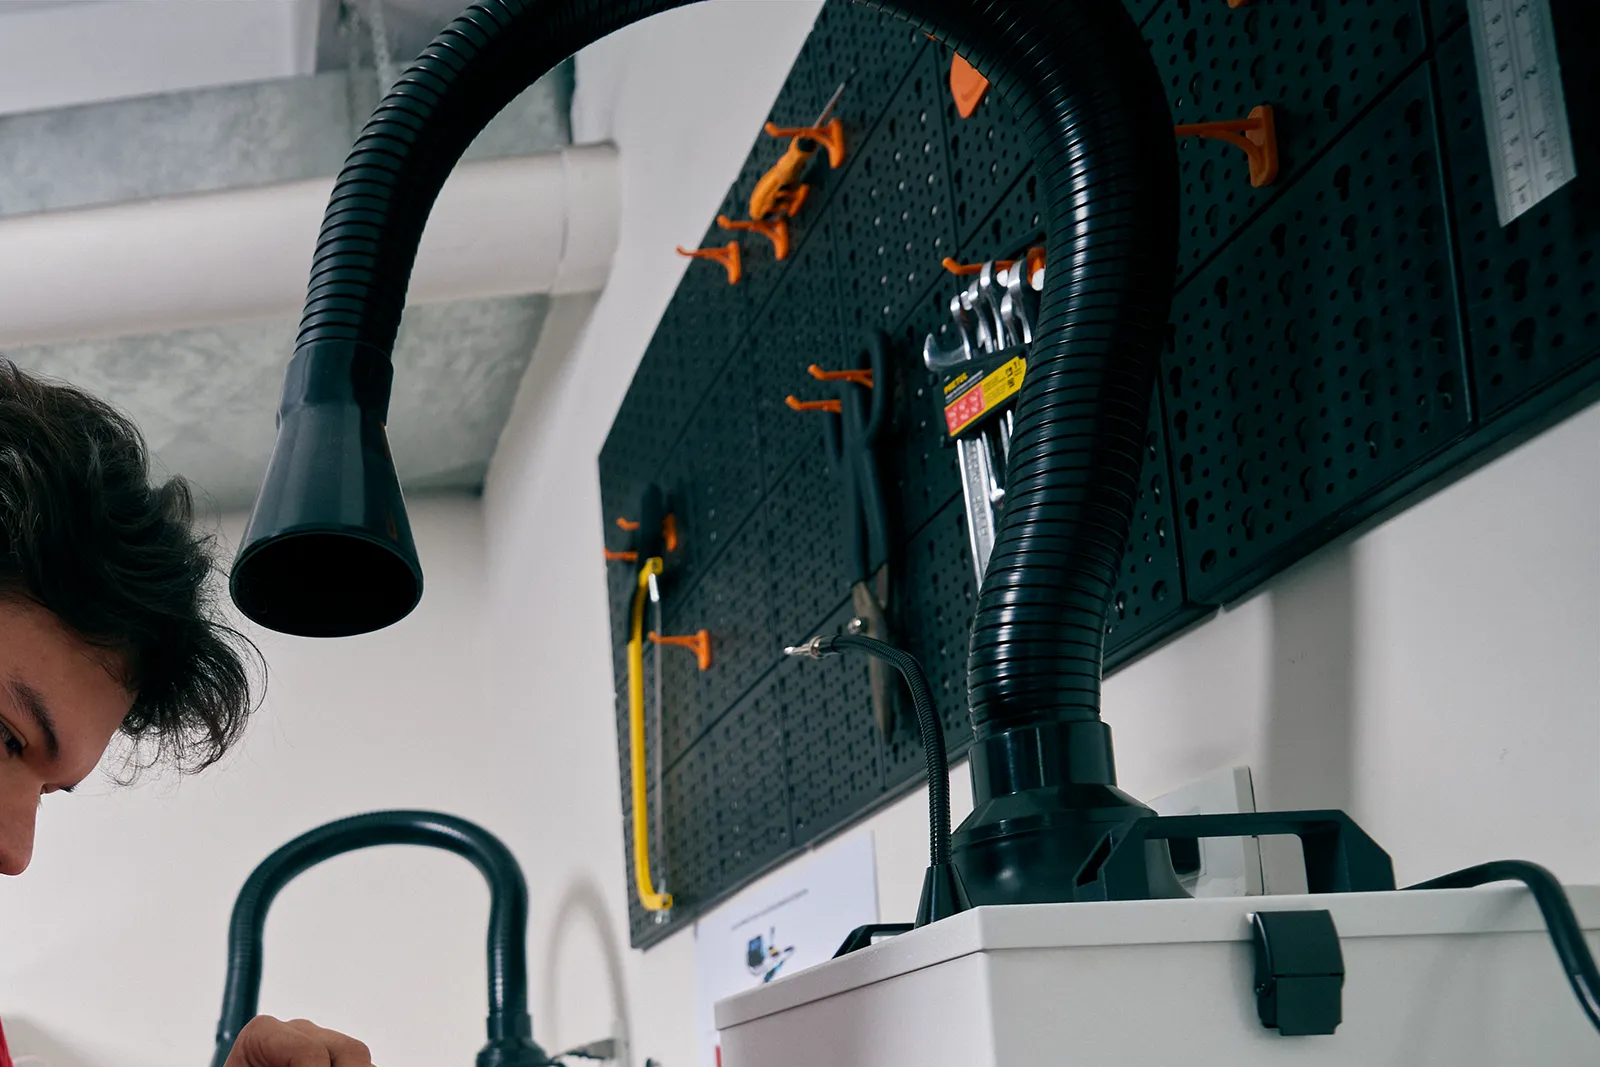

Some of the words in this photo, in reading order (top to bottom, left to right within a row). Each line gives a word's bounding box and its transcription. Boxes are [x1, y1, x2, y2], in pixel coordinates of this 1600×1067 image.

[1514, 3, 1528, 18] 3
[1523, 65, 1538, 80] 2
[1500, 87, 1514, 101] 5
